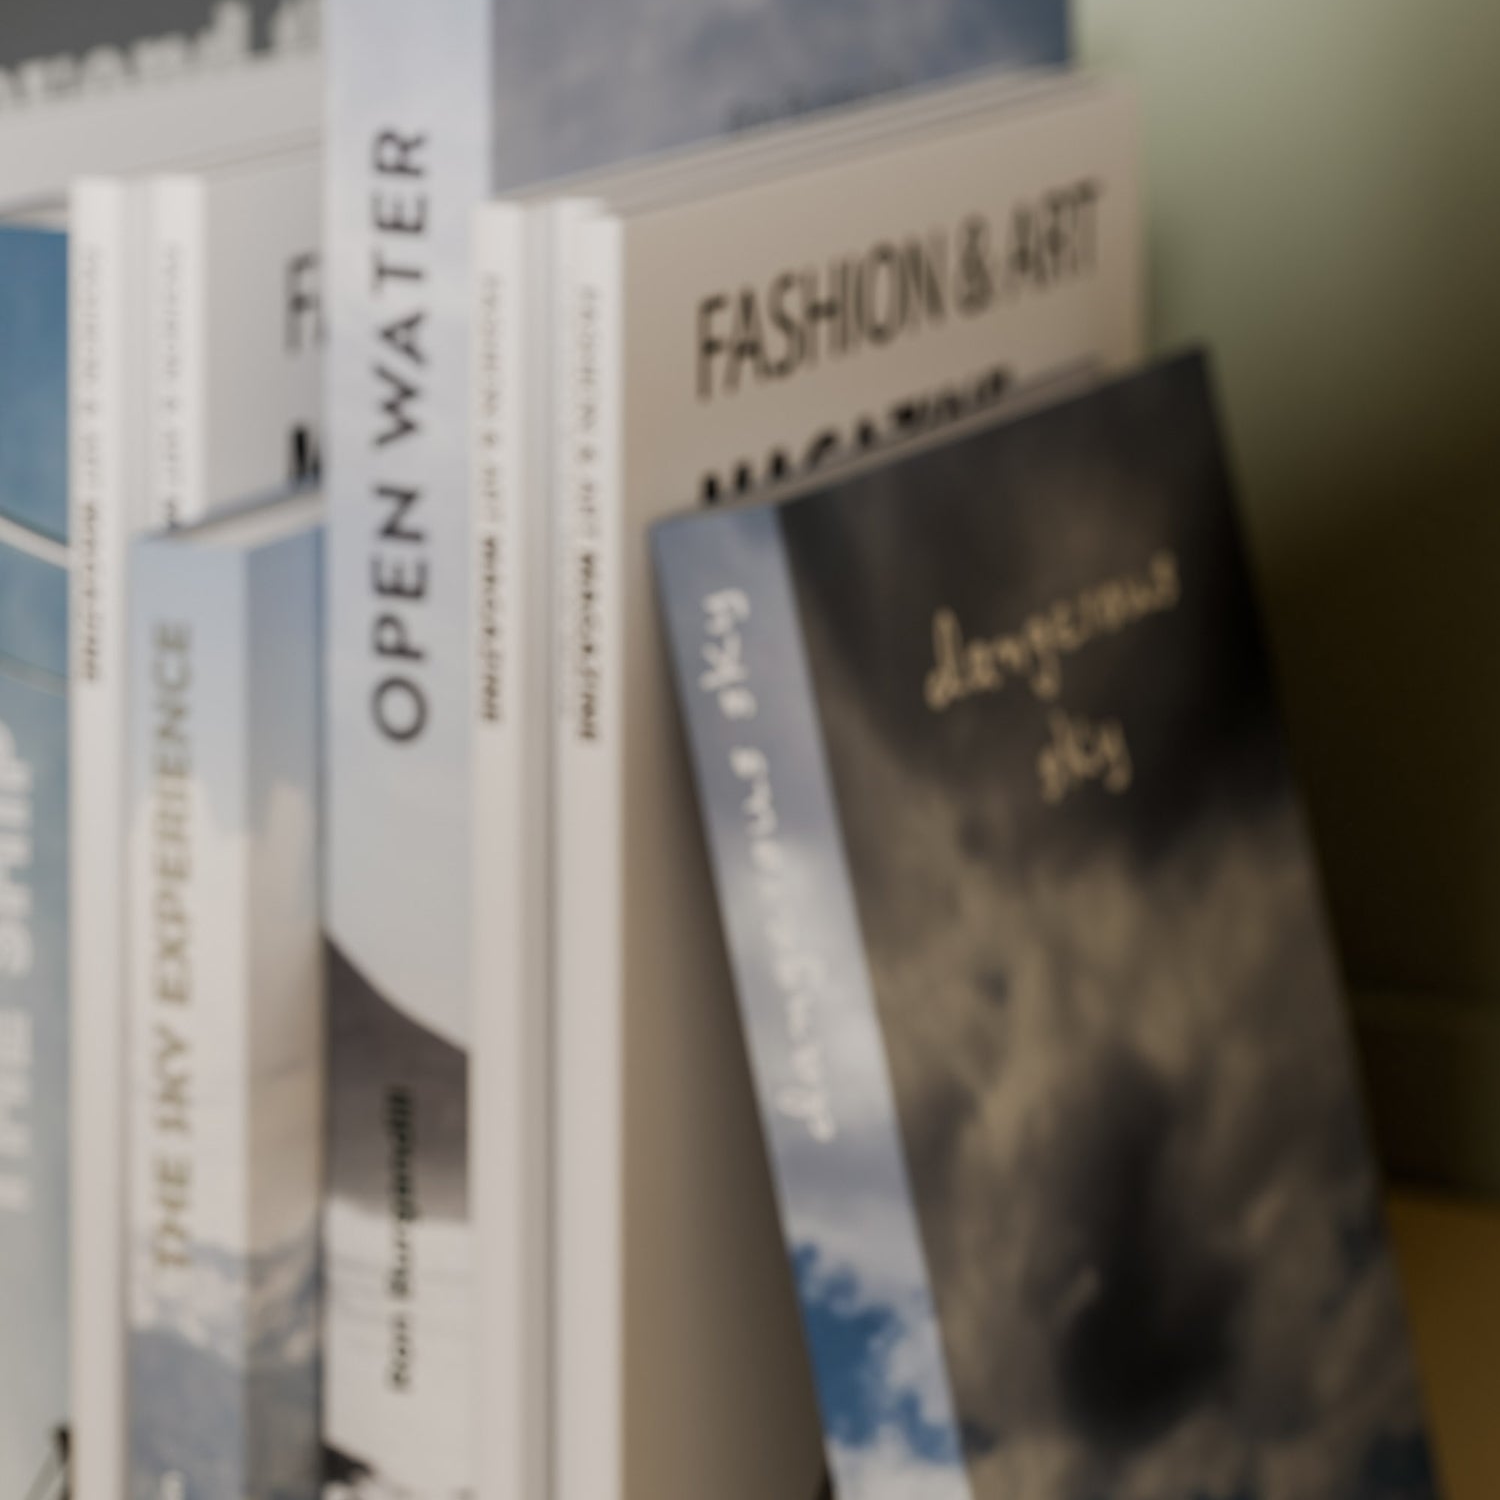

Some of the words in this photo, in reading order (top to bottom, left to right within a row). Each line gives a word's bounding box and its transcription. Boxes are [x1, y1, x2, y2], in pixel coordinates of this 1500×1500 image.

[369, 123, 429, 449] WATER
[697, 229, 947, 400] FASHION
[952, 212, 995, 322] &
[1003, 177, 1100, 301] ART
[369, 482, 430, 744] OPEN
[700, 587, 758, 721] sky
[924, 549, 1180, 712] dangerous
[153, 618, 196, 1006] EXPERIENCE
[152, 1156, 194, 1269] THE
